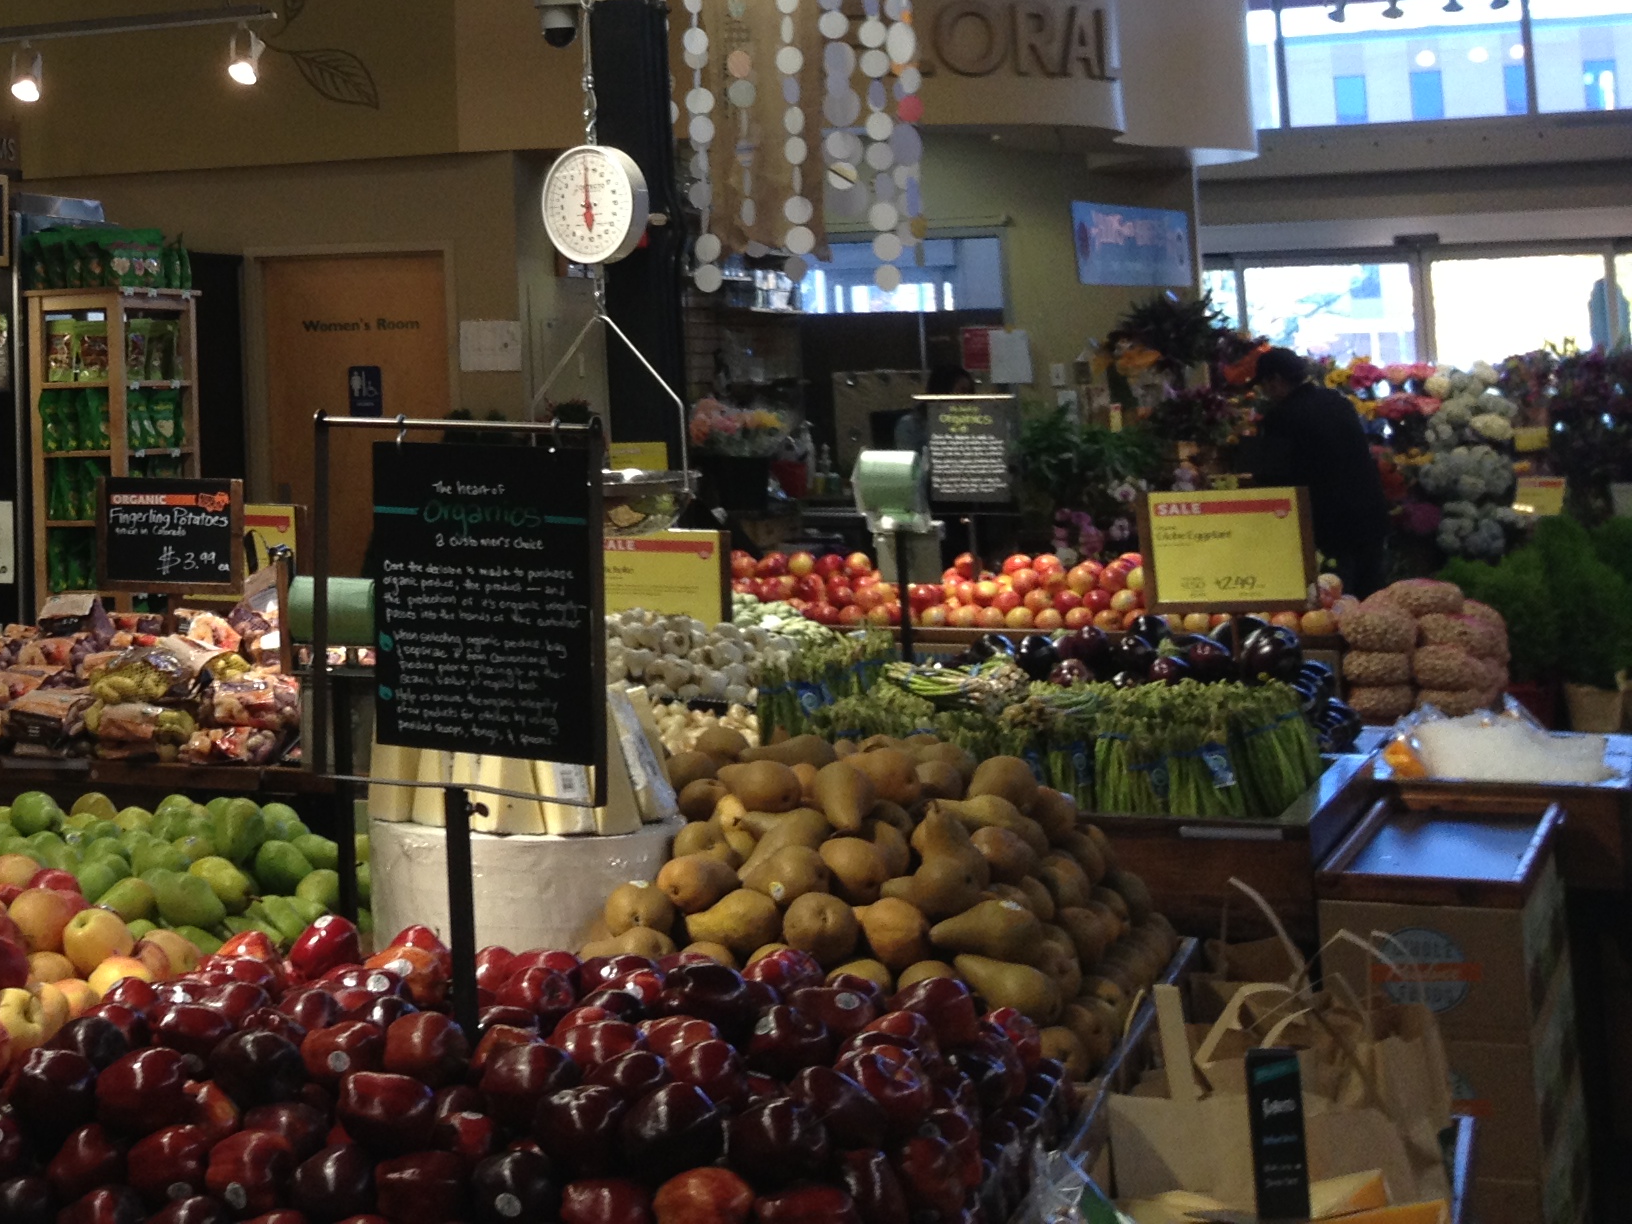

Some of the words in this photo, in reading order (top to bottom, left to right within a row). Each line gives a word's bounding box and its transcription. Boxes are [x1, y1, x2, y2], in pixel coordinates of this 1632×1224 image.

[914, 0, 1119, 82] ORAL
[302, 318, 371, 332] Women's
[376, 318, 420, 330] Room
[432, 480, 453, 494] The
[456, 480, 490, 495] heart
[112, 494, 168, 506] ORGANIC
[1157, 503, 1202, 516] SALE
[109, 507, 171, 528] Fingerling
[172, 507, 230, 527] Potatoes
[423, 498, 542, 538] Organics
[603, 540, 637, 551] ALE
